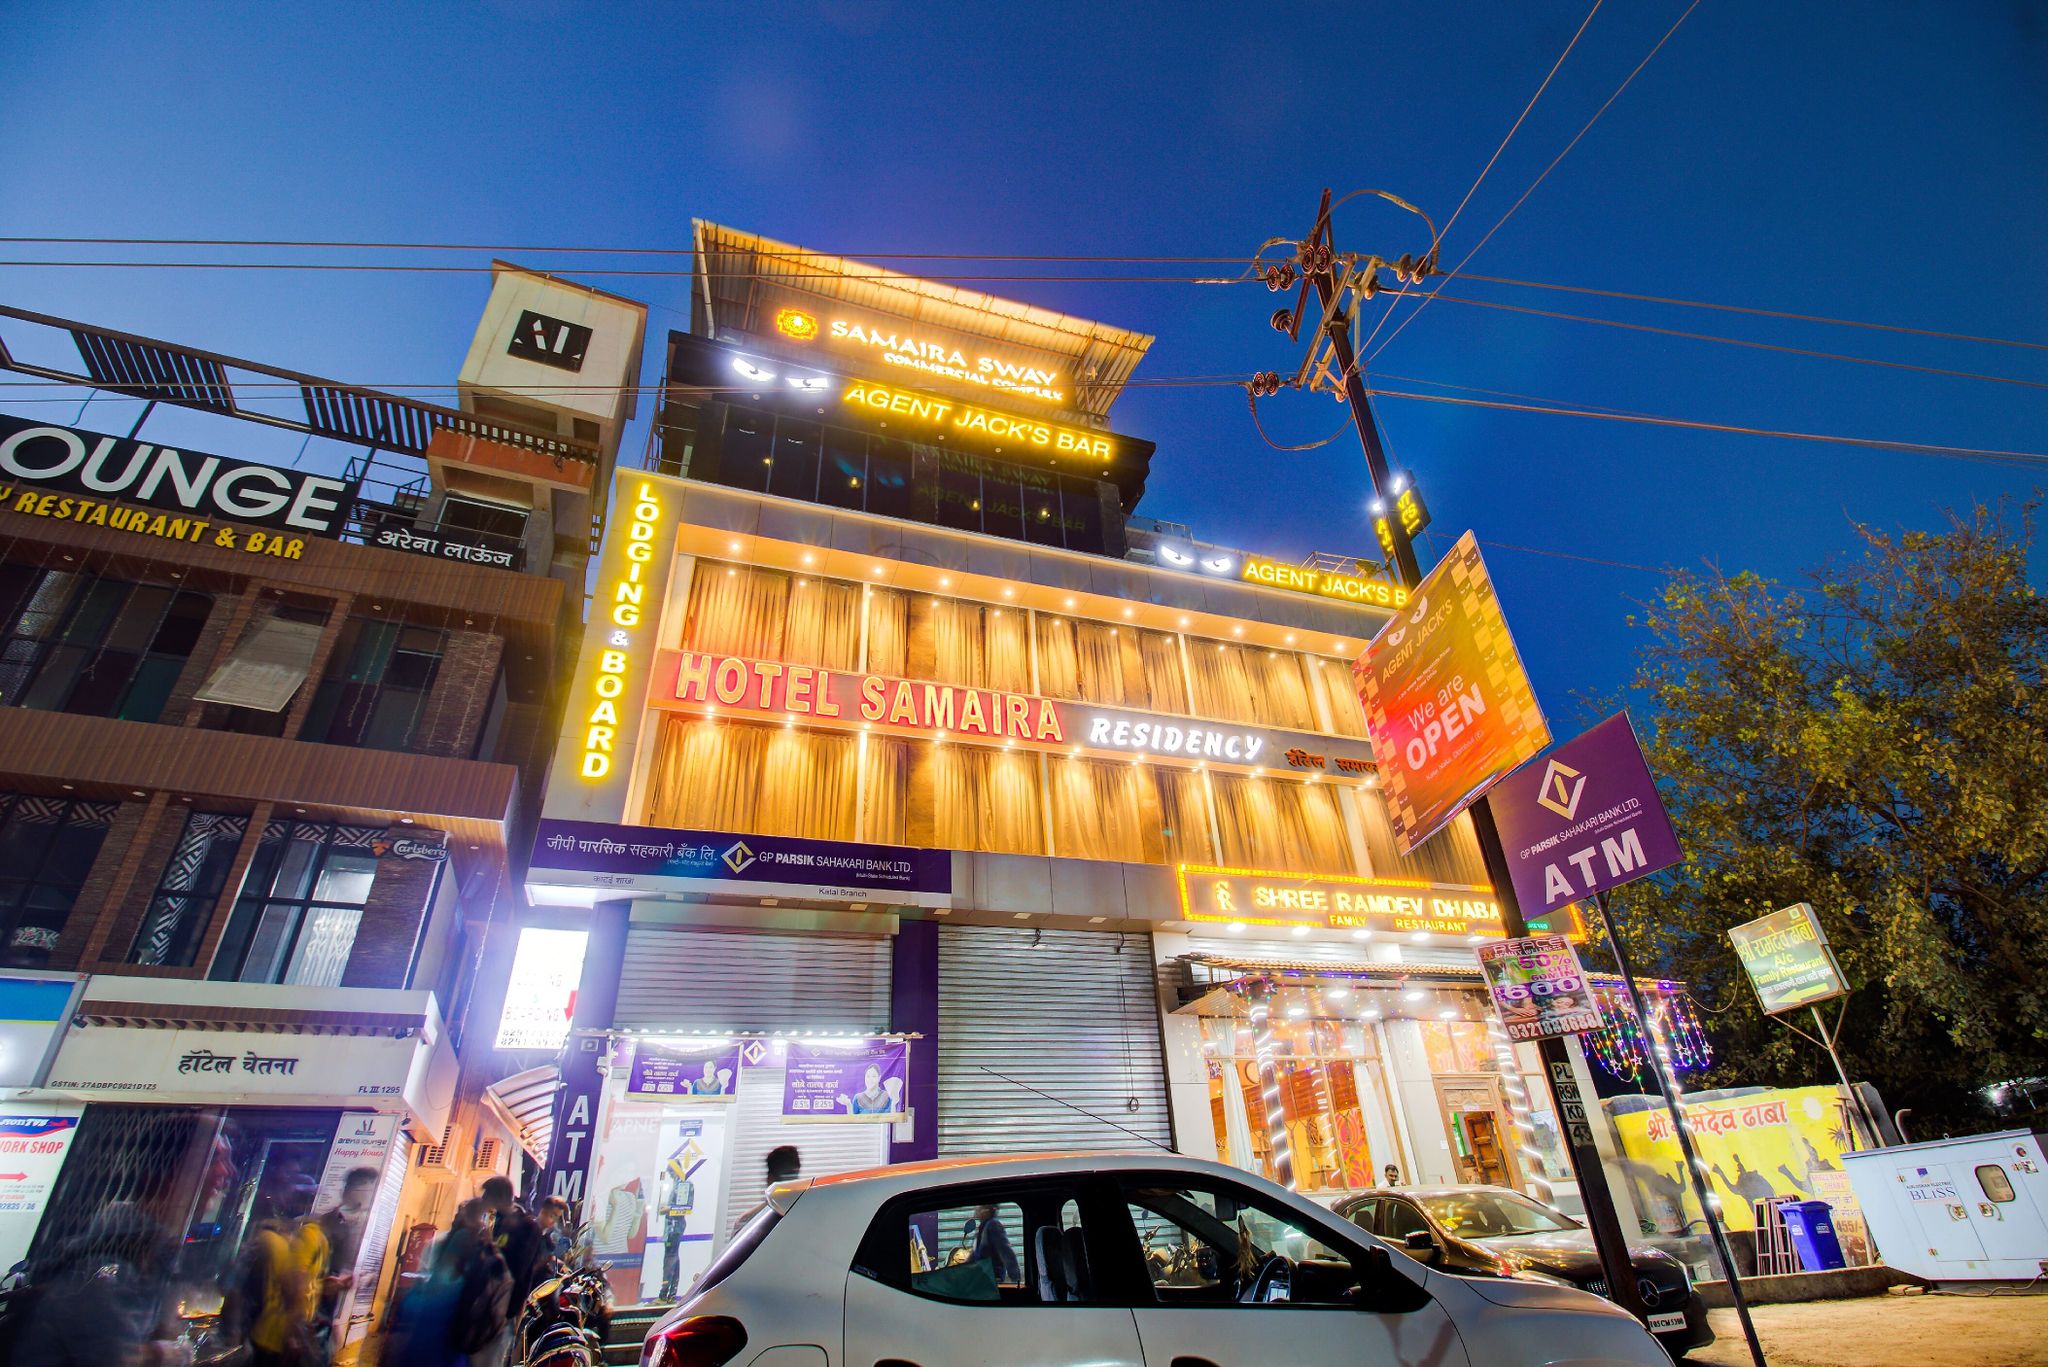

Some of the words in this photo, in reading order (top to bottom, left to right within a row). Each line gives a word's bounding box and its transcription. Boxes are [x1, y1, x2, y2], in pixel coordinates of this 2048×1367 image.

[831, 321, 967, 367] SAMAIRA
[978, 357, 1056, 386] SWAY
[883, 352, 989, 386] COMMERCIAL
[992, 378, 1063, 401] COMPLEX
[844, 385, 951, 421] AGENT
[955, 410, 1050, 445] JACK'S
[1057, 433, 1111, 459] BAR
[14, 491, 210, 543] RESTAURANT
[215, 527, 239, 549] &
[246, 531, 305, 560] BAR
[377, 528, 439, 553] अरेना
[444, 544, 513, 567] लाऊंज
[613, 483, 660, 626] LODGING
[1244, 562, 1318, 589] AGENT
[1322, 577, 1389, 603] JACK'S
[1382, 639, 1413, 684] AGENT
[1416, 599, 1453, 647] JACK'S
[676, 653, 839, 717] HOTEL
[861, 676, 1063, 742] SAMAIRA
[1408, 702, 1435, 732] We
[1438, 675, 1464, 706] are
[580, 650, 626, 778] BOARD
[1406, 682, 1486, 771] OPEN
[1089, 718, 1263, 760] RESIDENCY
[1520, 848, 1530, 860] GP
[1531, 834, 1560, 856] PARSIK
[1559, 816, 1598, 842] SAHAKARI
[1598, 805, 1622, 823] BANK
[1621, 797, 1642, 814] LTD.
[393, 840, 447, 860] Carlsberg
[547, 834, 576, 851] जीपी
[579, 838, 626, 856] पारसिक
[630, 843, 673, 859] सहकारी
[677, 843, 697, 859] बँक
[759, 851, 774, 863] GP
[776, 853, 814, 866] PARSIK
[816, 855, 865, 869] SAHAKARI
[866, 859, 892, 871] BANK
[893, 861, 913, 873] LTD.
[1546, 828, 1648, 905] ATM
[840, 888, 867, 898] Branch
[1254, 887, 1329, 911] SHREE
[1335, 892, 1423, 916] RAMDEV
[1431, 898, 1501, 920] DHABA
[1329, 915, 1367, 927] FAMILY
[1395, 918, 1468, 932] RESTAURANT
[1493, 937, 1562, 954] PEACE
[1519, 953, 1571, 969] 50%
[1753, 969, 1780, 985] Family
[1779, 955, 1826, 978] Restaurant
[1505, 977, 1581, 1000] 600
[178, 1050, 236, 1075] हॉटेल
[243, 1050, 299, 1076] चेतना
[1553, 1063, 1574, 1079] PL
[51, 1080, 79, 1088] GSTIN:
[358, 1085, 369, 1094] FL
[381, 1086, 401, 1094] 1295
[1566, 1104, 1587, 1120] KD
[1648, 1112, 1669, 1141] श्री
[1671, 1104, 1738, 1135] मदेव
[1739, 1100, 1788, 1127] ढाबा
[611, 1119, 658, 1136] APNE
[0, 1141, 29, 1153] ORK
[30, 1142, 64, 1154] SHOP
[334, 1148, 359, 1159] Happy
[552, 1095, 590, 1202] ATM
[1909, 1187, 1957, 1201] BLISS
[1836, 1220, 1863, 1233] 455/-
